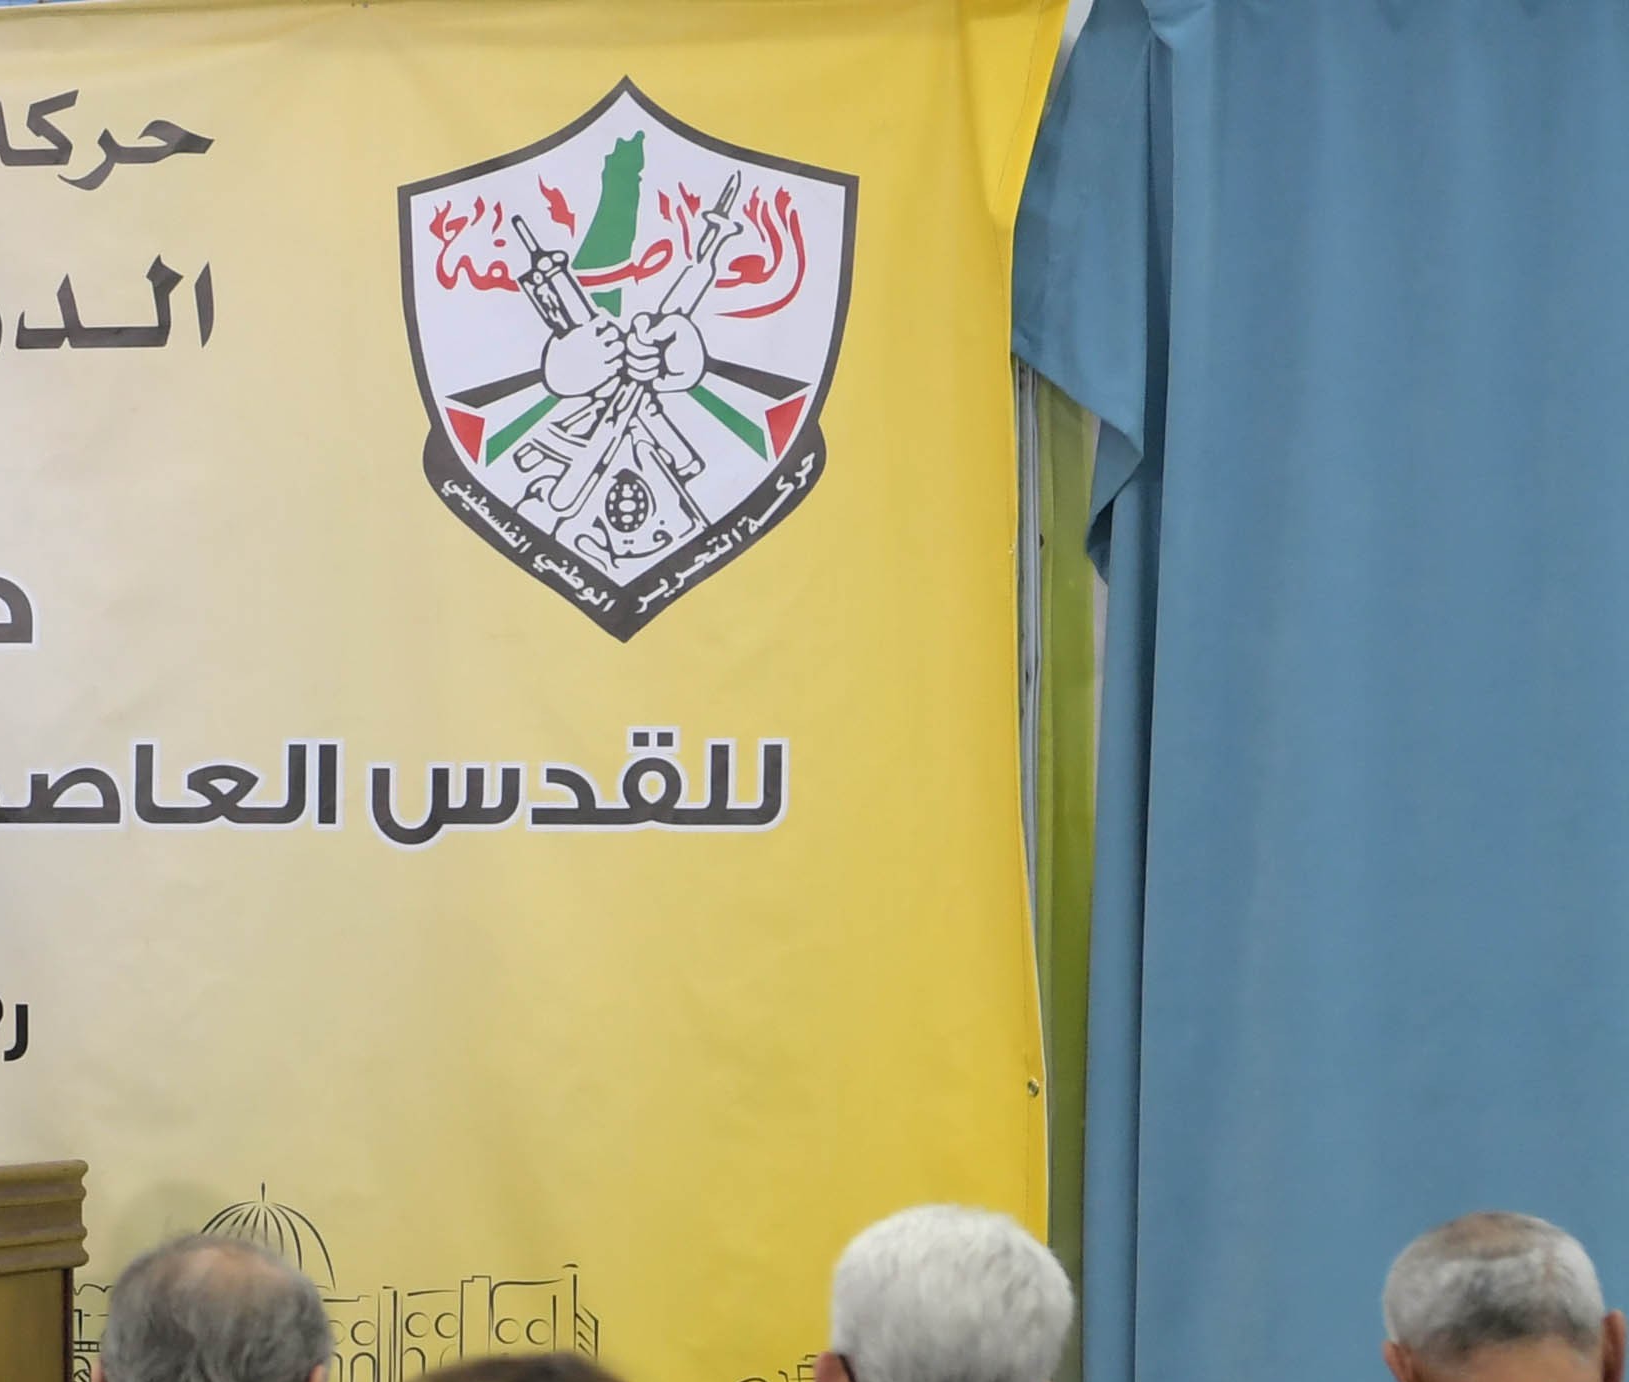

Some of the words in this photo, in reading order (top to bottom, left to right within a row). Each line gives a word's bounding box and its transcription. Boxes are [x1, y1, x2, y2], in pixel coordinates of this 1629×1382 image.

[441, 477, 531, 555] الفلسطيني
[738, 450, 817, 536] حركة
[533, 551, 616, 613] الوطني
[635, 527, 744, 614] التحرير
[371, 731, 783, 846] للقدس
